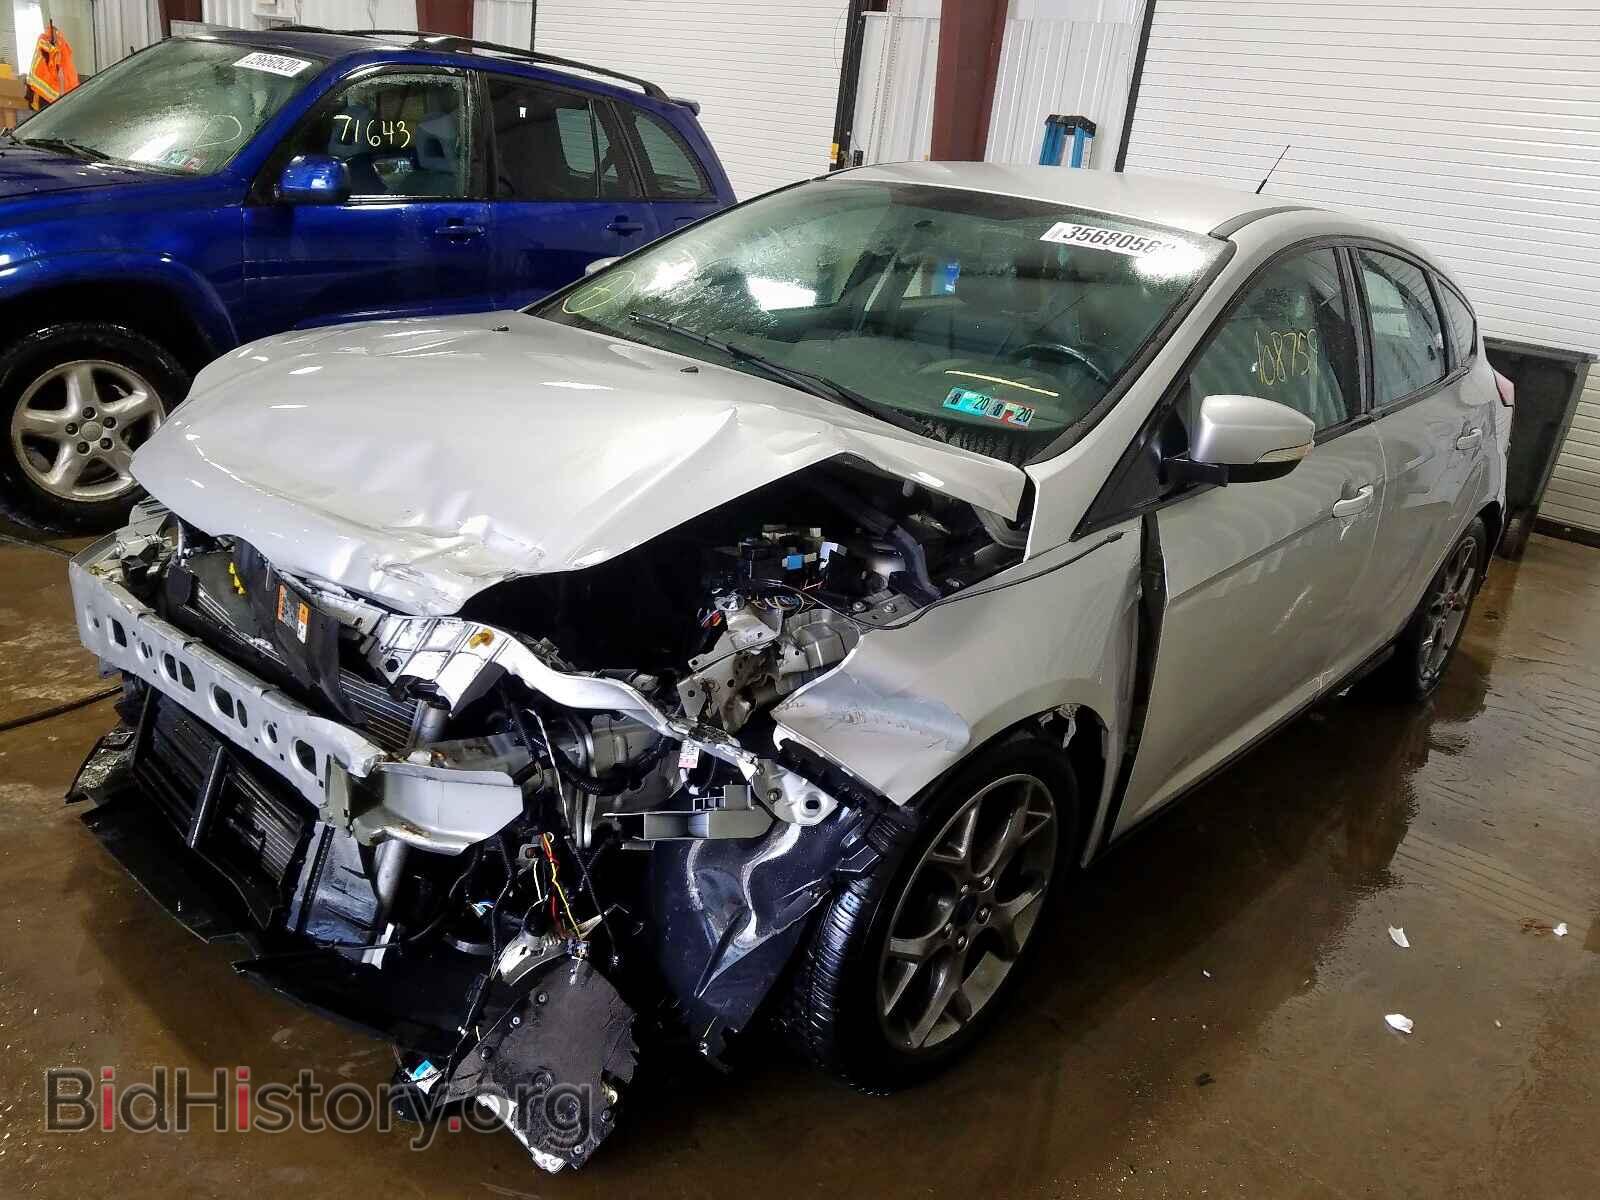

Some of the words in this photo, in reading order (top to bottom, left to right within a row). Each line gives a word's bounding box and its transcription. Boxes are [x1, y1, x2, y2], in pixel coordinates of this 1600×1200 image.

[333, 114, 411, 148] 71643
[1062, 225, 1177, 257] 3568056
[950, 393, 962, 405] 8
[973, 396, 990, 411] 20
[992, 403, 1004, 417] 8
[1015, 407, 1032, 423] 20
